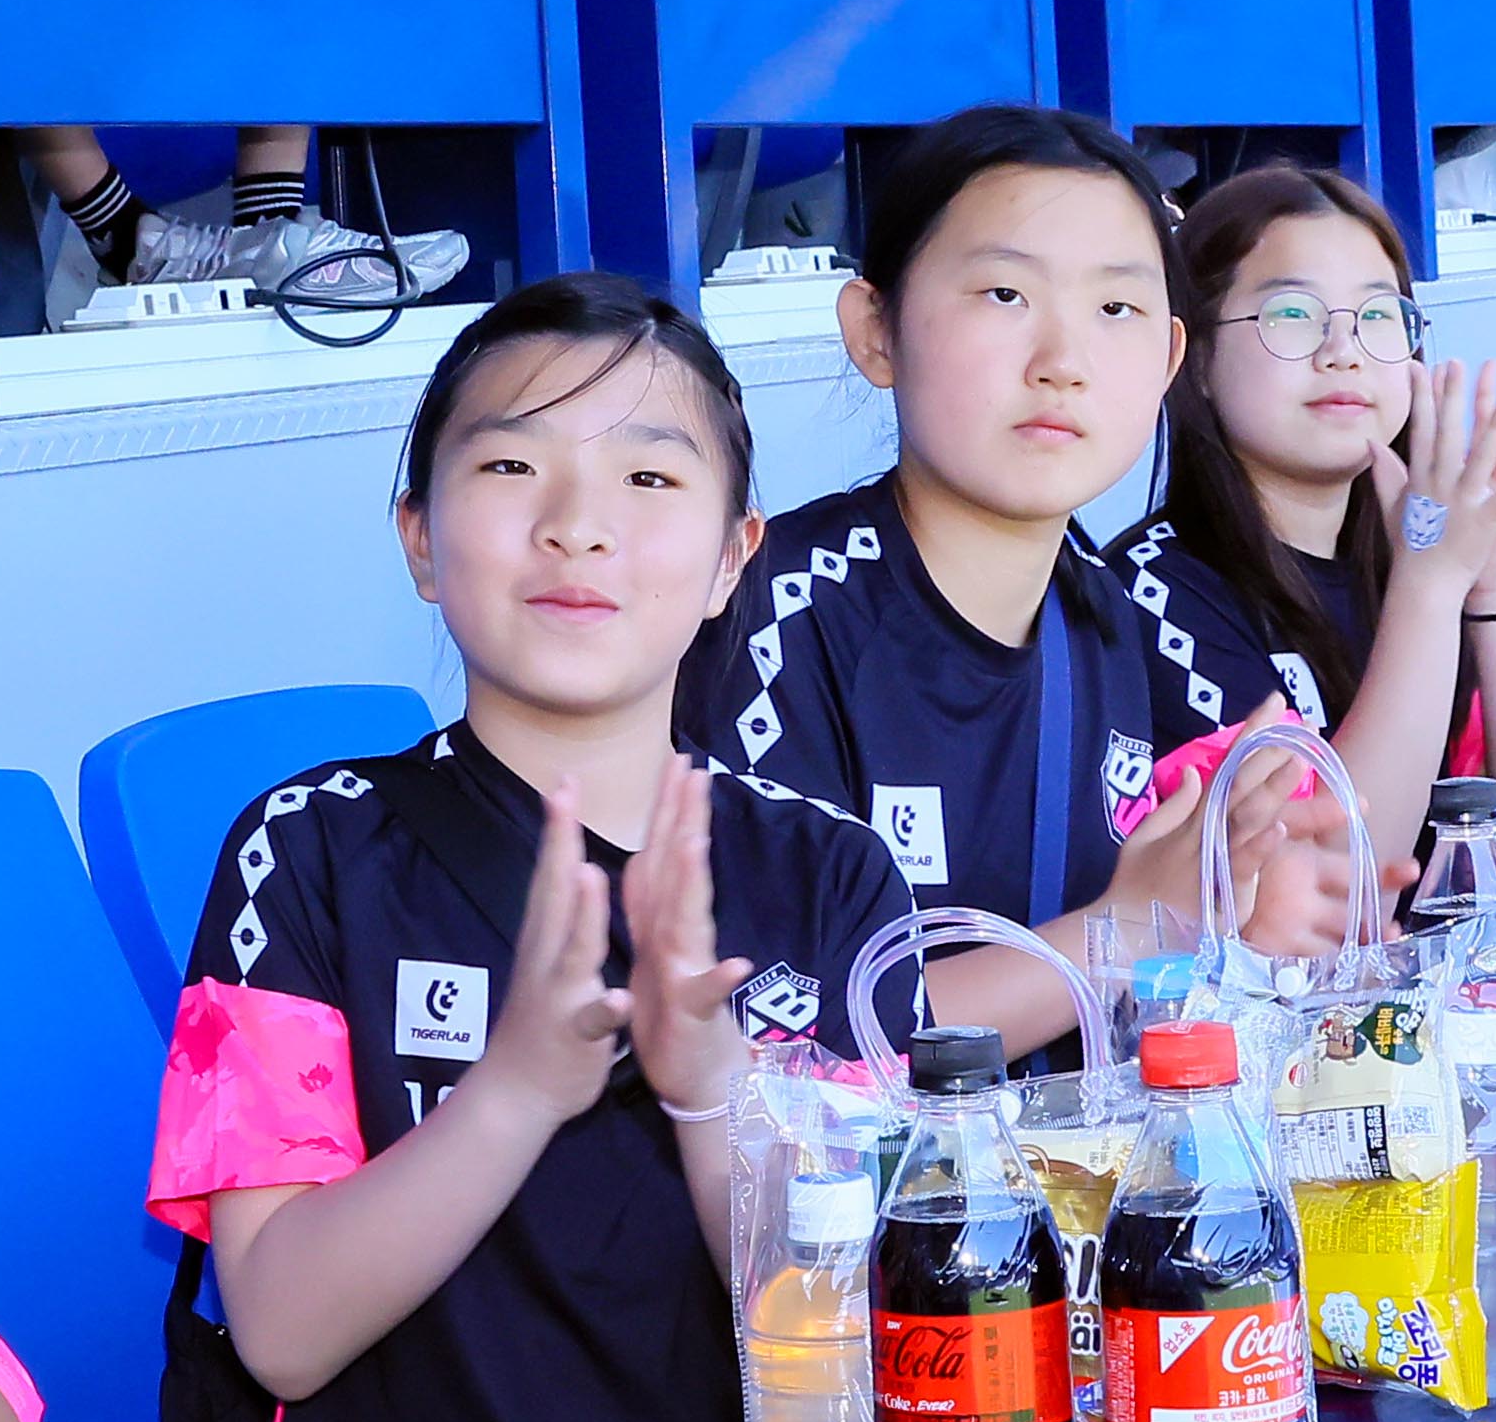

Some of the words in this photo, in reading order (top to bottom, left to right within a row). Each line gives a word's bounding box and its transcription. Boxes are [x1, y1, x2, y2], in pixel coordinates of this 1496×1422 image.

[748, 971, 778, 993] ULSAN
[410, 1028, 470, 1044] TIGERLAB
[1164, 1321, 1196, 1354] 업소용
[1243, 1365, 1295, 1385] ORIGINAL
[916, 1400, 954, 1412] EVER?
